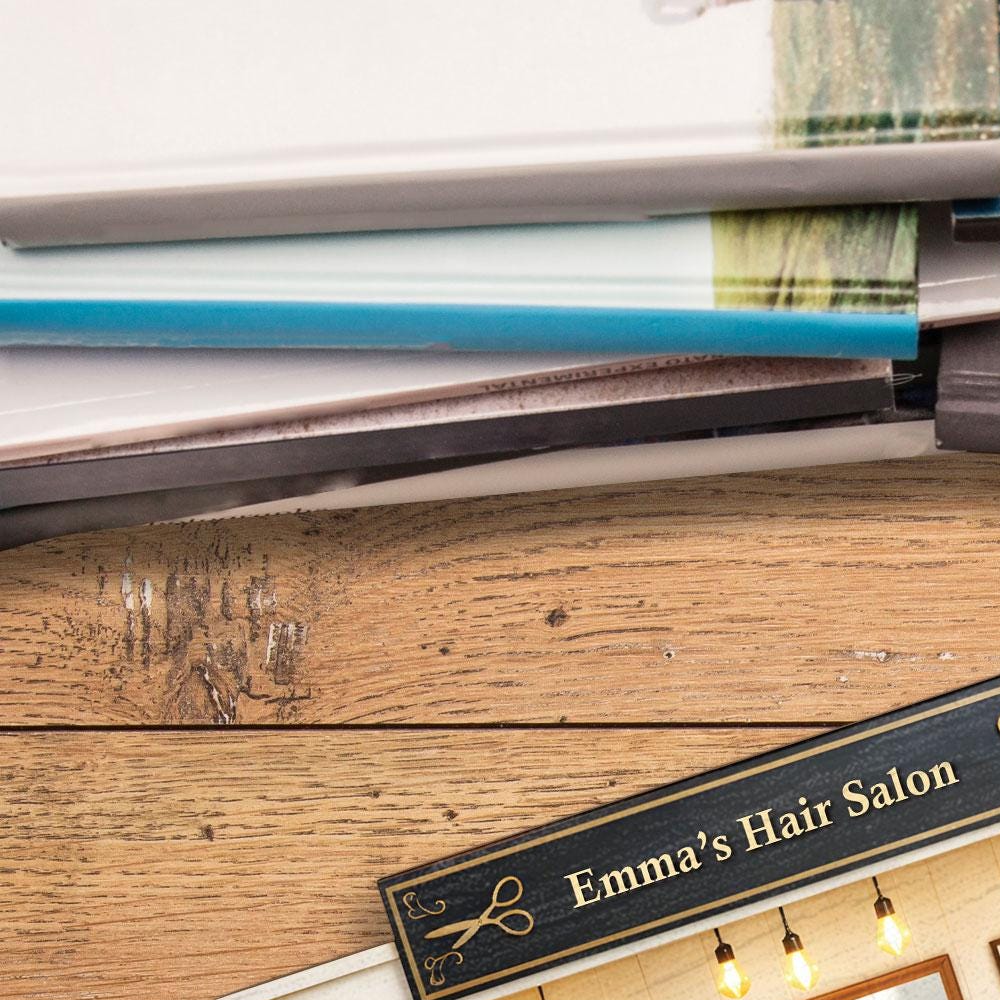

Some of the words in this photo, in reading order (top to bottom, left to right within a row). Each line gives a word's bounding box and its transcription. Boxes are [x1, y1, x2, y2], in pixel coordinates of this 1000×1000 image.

[563, 831, 733, 910] Emma's
[736, 796, 834, 852] Hair
[842, 758, 961, 817] Salon
